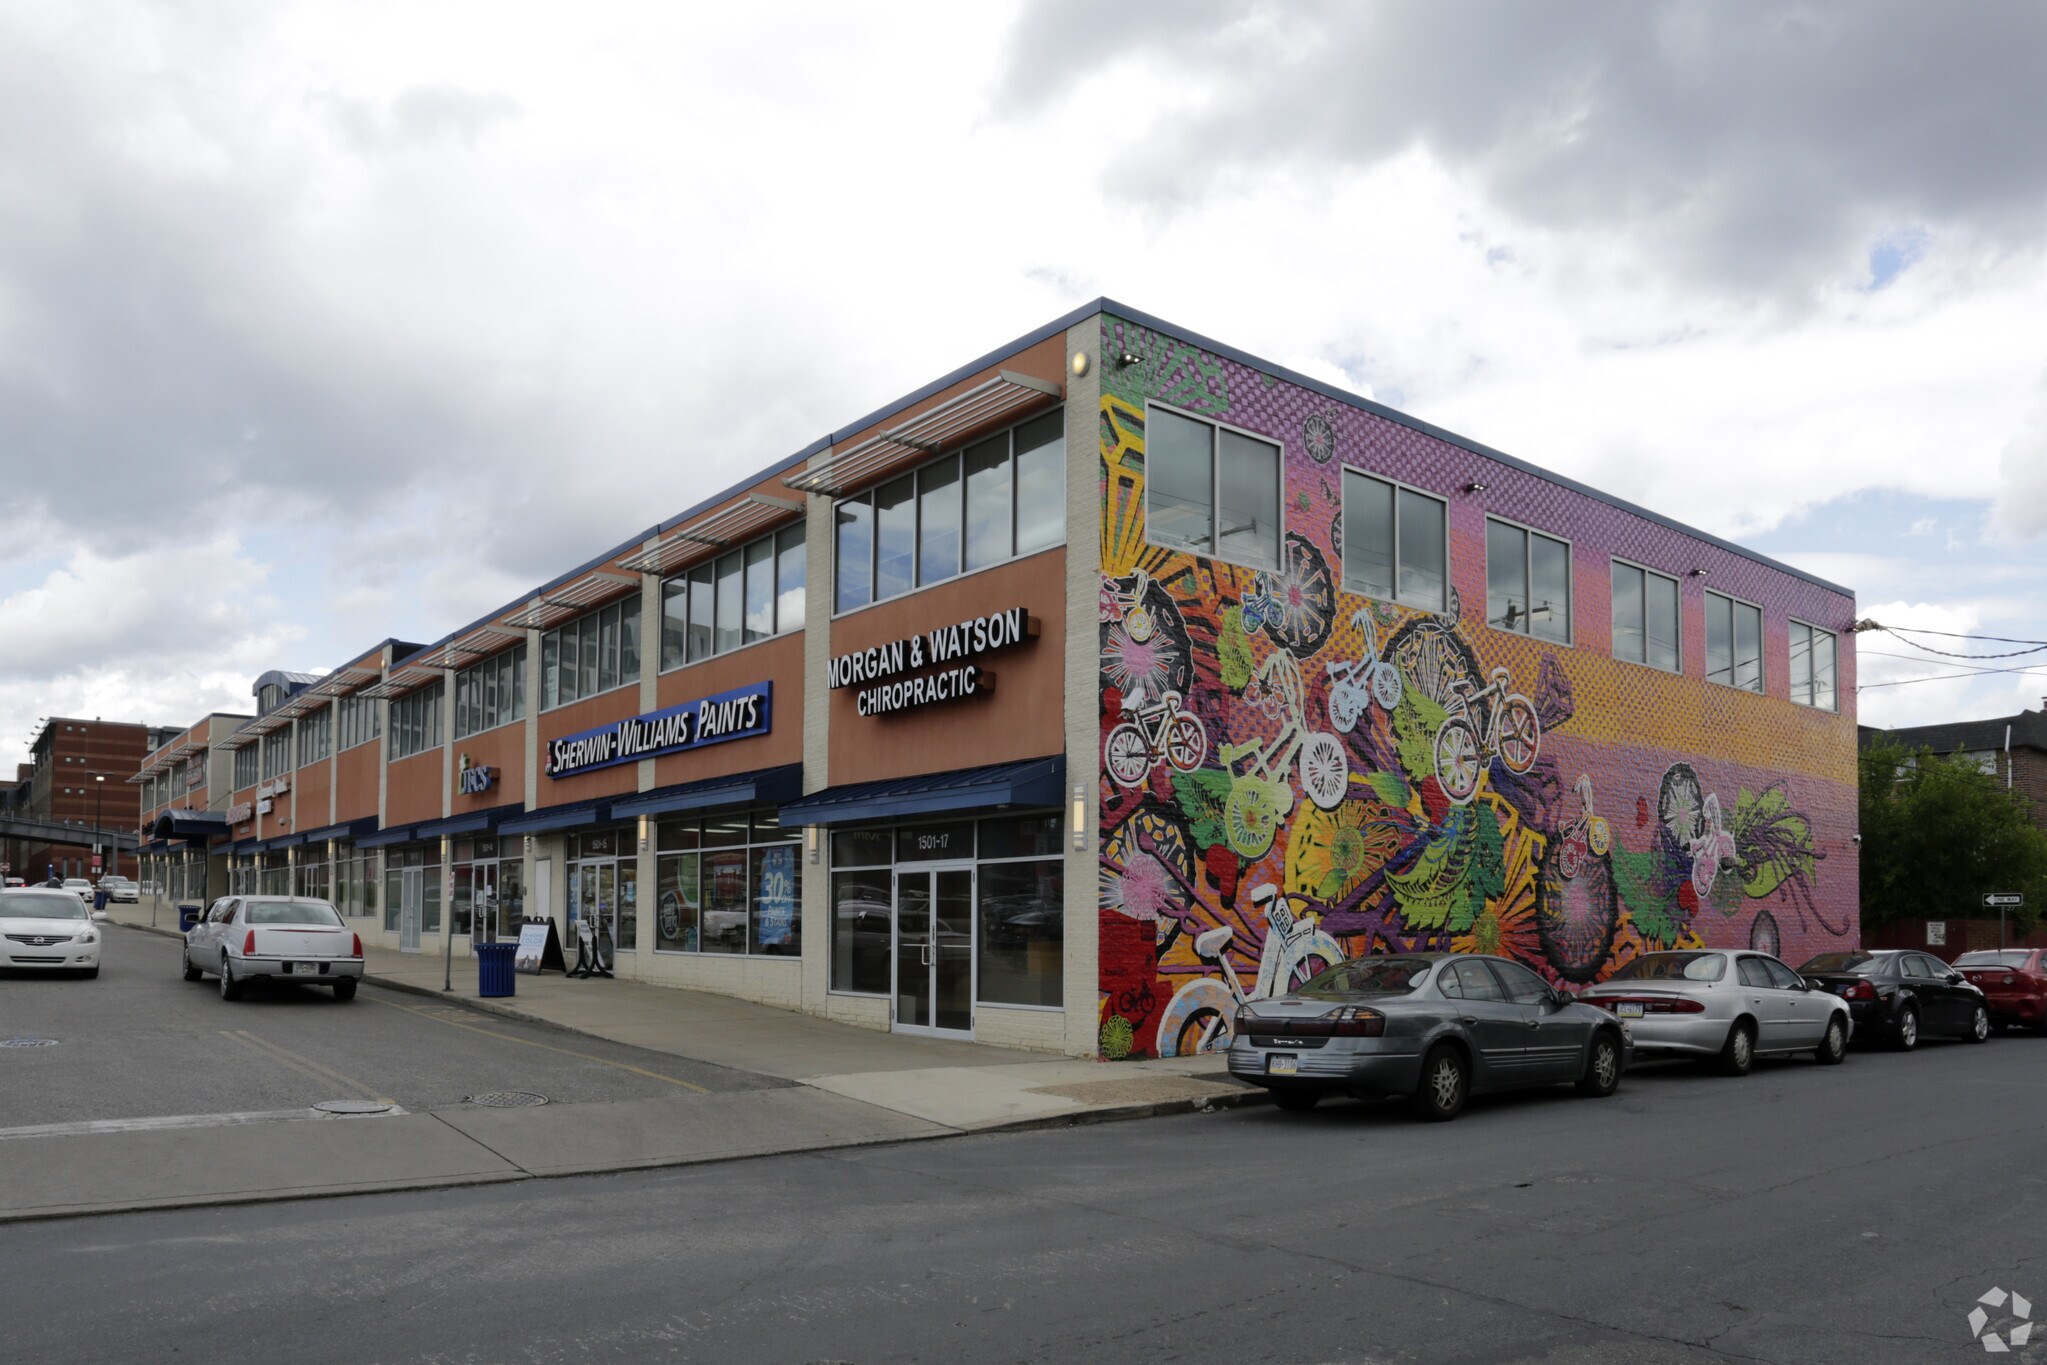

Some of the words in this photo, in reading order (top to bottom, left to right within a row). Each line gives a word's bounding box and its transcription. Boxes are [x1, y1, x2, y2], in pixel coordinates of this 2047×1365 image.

[827, 640, 903, 689] MORGAN
[910, 634, 924, 668] &
[930, 607, 1021, 663] WATSON
[857, 665, 976, 717] CHIROPRACTIC
[918, 833, 949, 850] 1501-17
